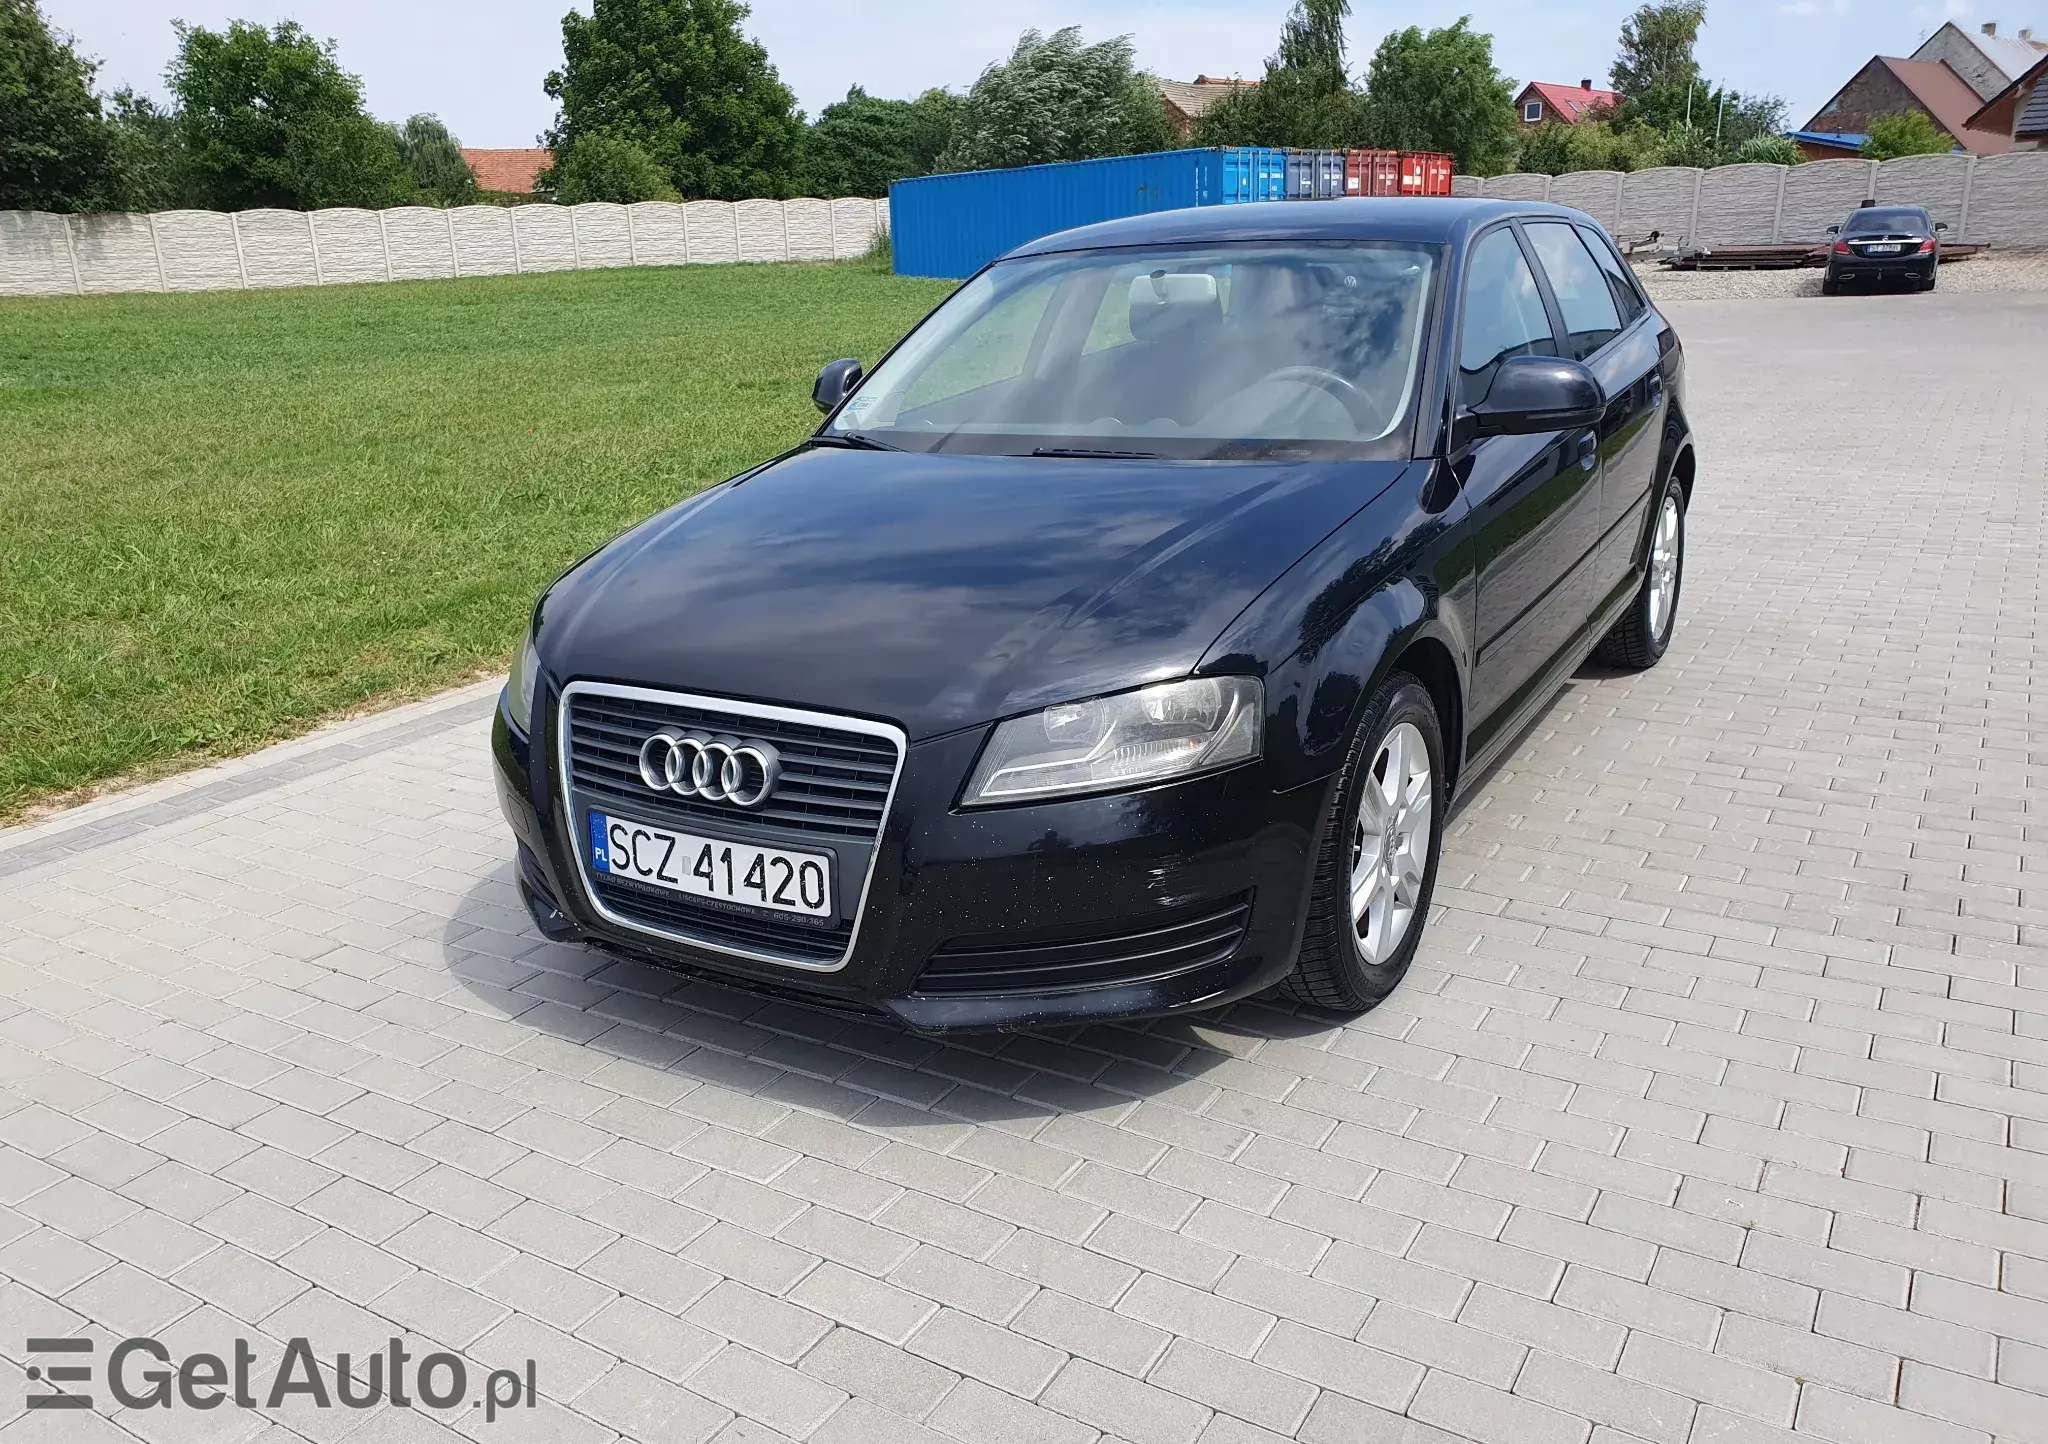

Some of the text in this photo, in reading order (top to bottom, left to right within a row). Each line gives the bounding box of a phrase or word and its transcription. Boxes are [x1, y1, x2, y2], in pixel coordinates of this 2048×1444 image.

[595, 848, 608, 862] PL
[609, 823, 824, 910] SCZ 41420
